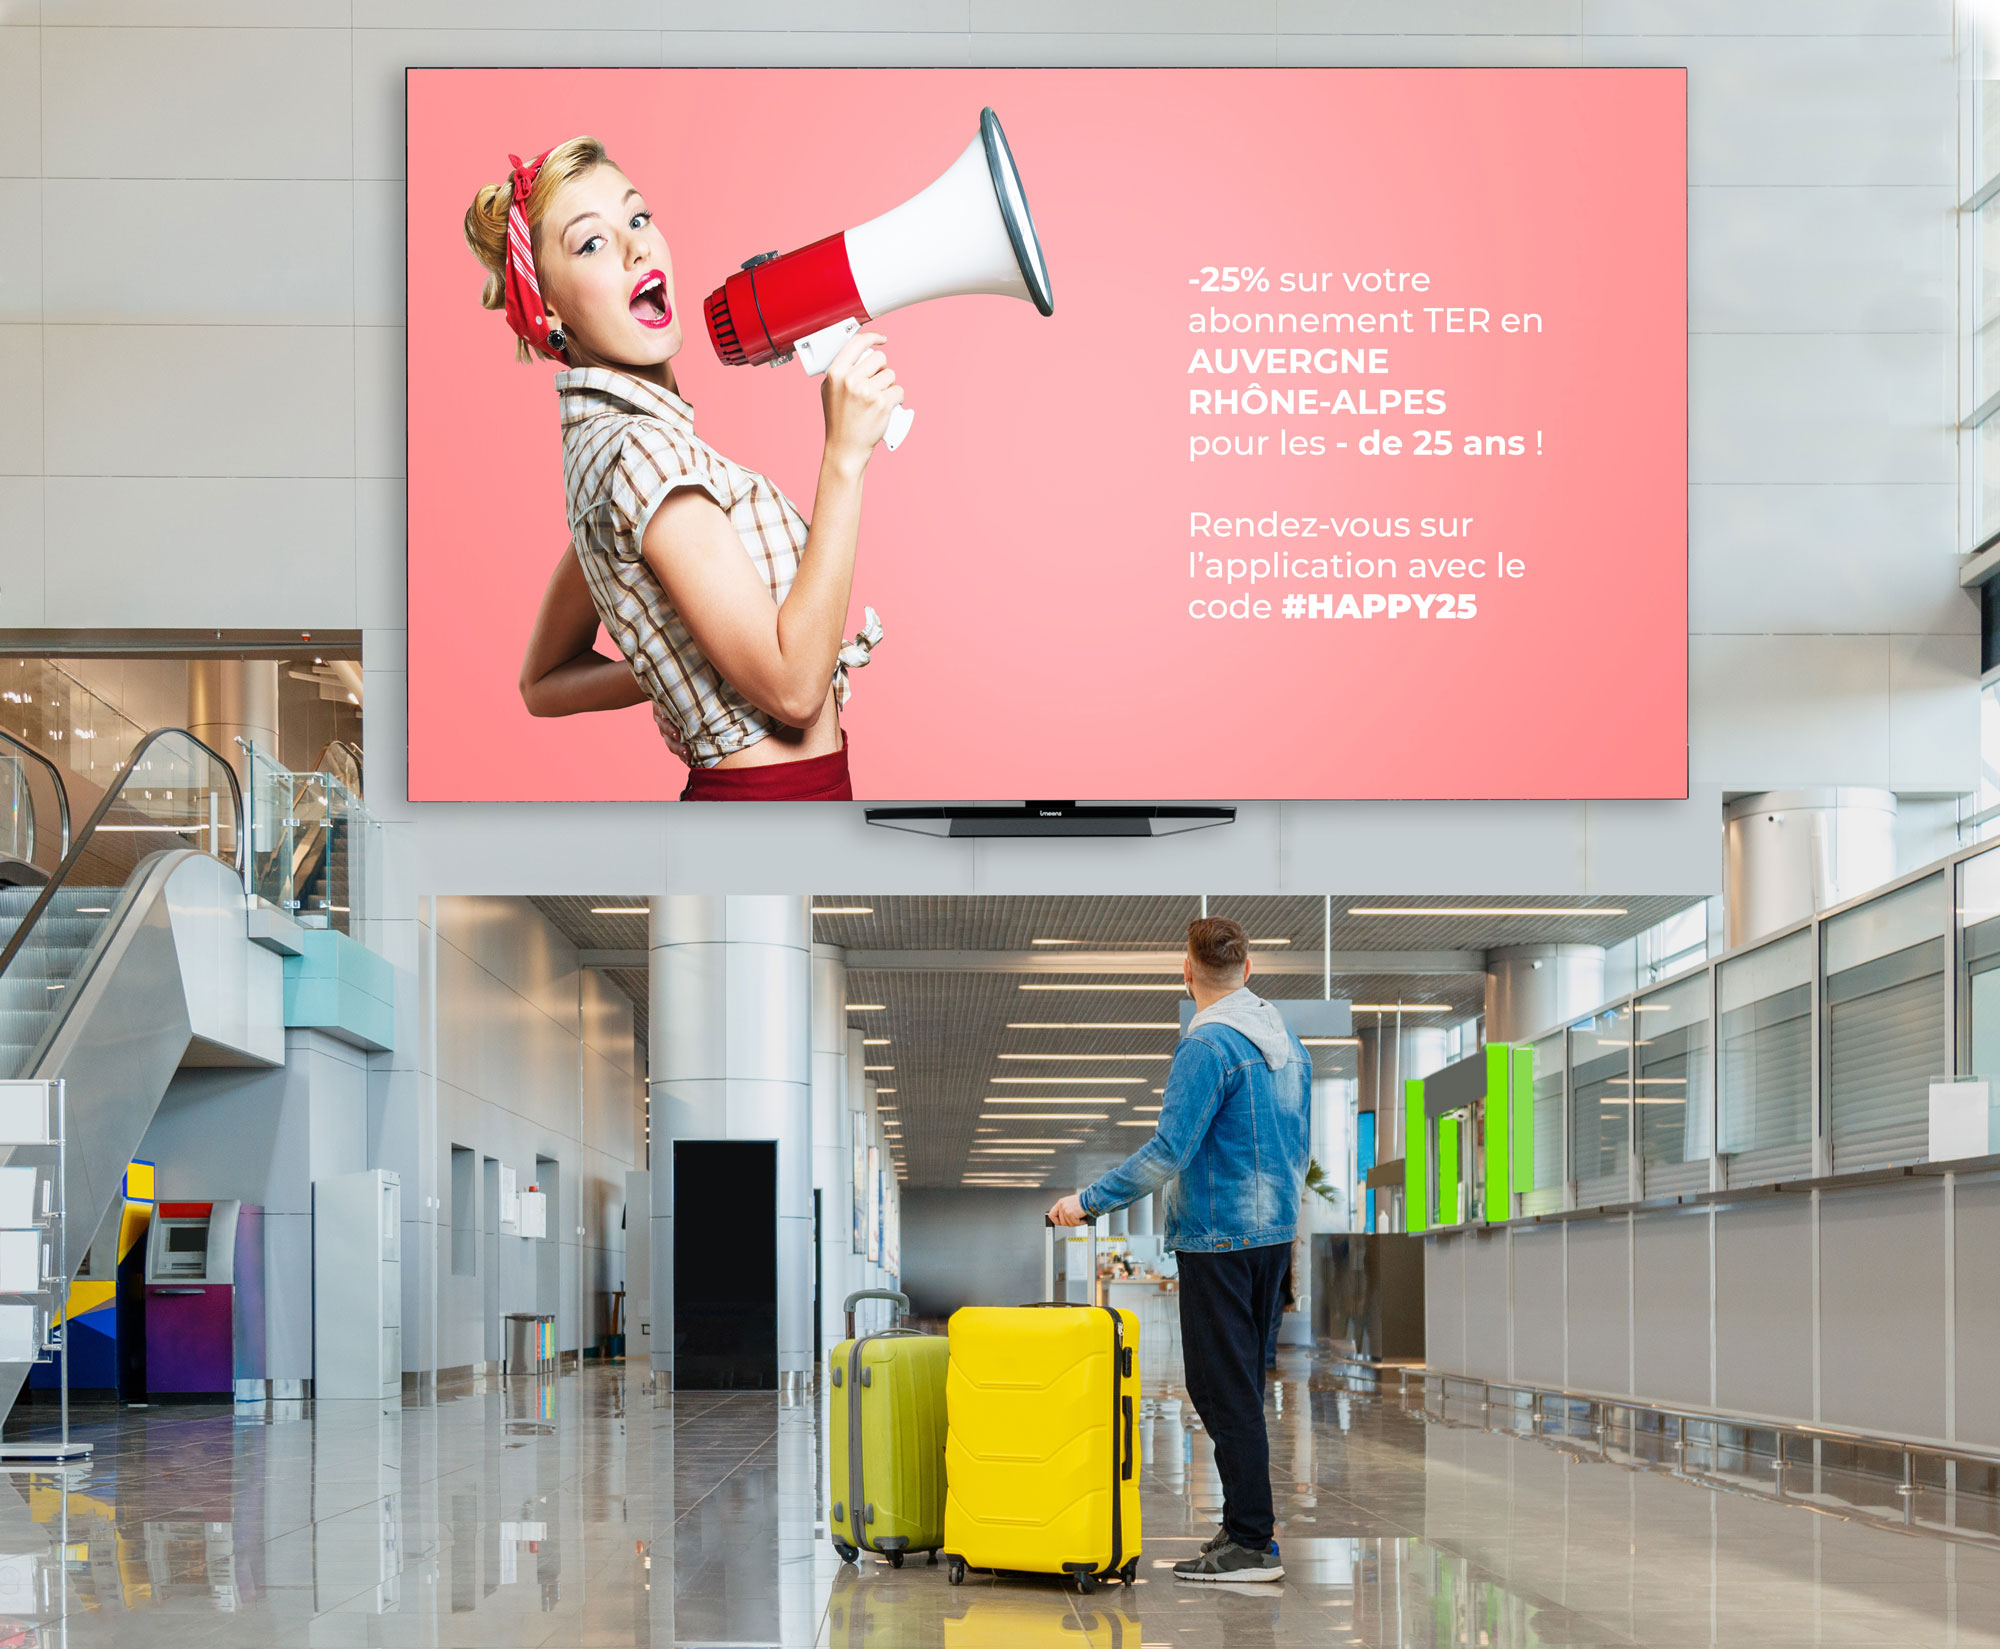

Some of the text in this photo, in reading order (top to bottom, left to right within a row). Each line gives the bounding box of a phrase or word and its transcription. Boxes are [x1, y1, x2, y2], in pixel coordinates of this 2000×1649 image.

[1189, 266, 1431, 292] -25% sur votre
[1188, 307, 1543, 333] abonnement TER en
[1187, 348, 1389, 374] AUVERGNE
[1189, 383, 1447, 415] RHÔNE-ALPES
[1190, 435, 1269, 461] pour
[1281, 429, 1326, 455] les
[1358, 429, 1403, 456] de
[1413, 430, 1453, 456] 25
[1463, 435, 1525, 456] ans
[1536, 430, 1543, 456] !
[1190, 510, 1474, 537] Rendez-vous sur
[1408, 558, 1486, 579] avec
[1497, 552, 1526, 579] le
[1188, 593, 1477, 619] code #HAPPY25
